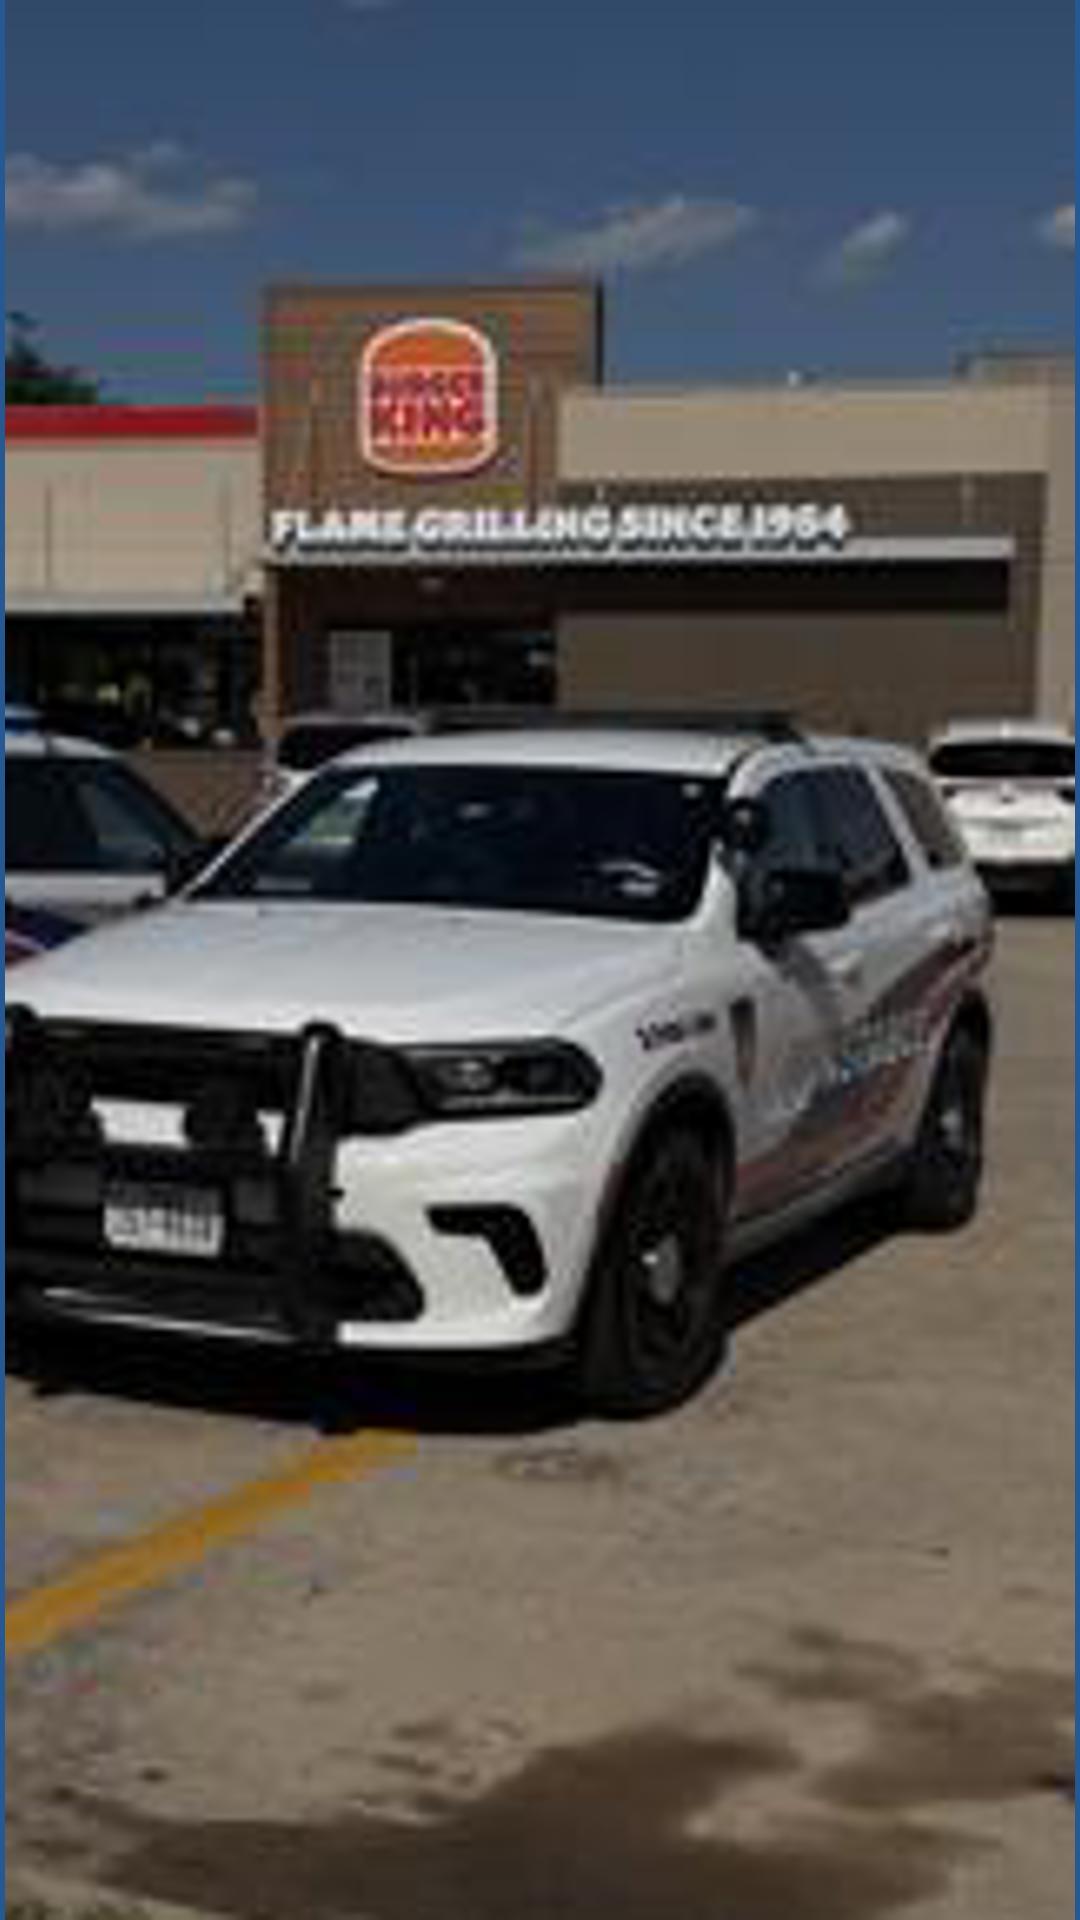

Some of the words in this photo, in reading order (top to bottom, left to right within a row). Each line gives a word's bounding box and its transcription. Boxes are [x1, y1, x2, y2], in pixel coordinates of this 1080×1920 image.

[369, 369, 485, 398] BURGER
[368, 400, 485, 442] KING
[271, 508, 406, 546] FLAME
[415, 508, 613, 543] GRILLING
[617, 503, 745, 542] SINCE
